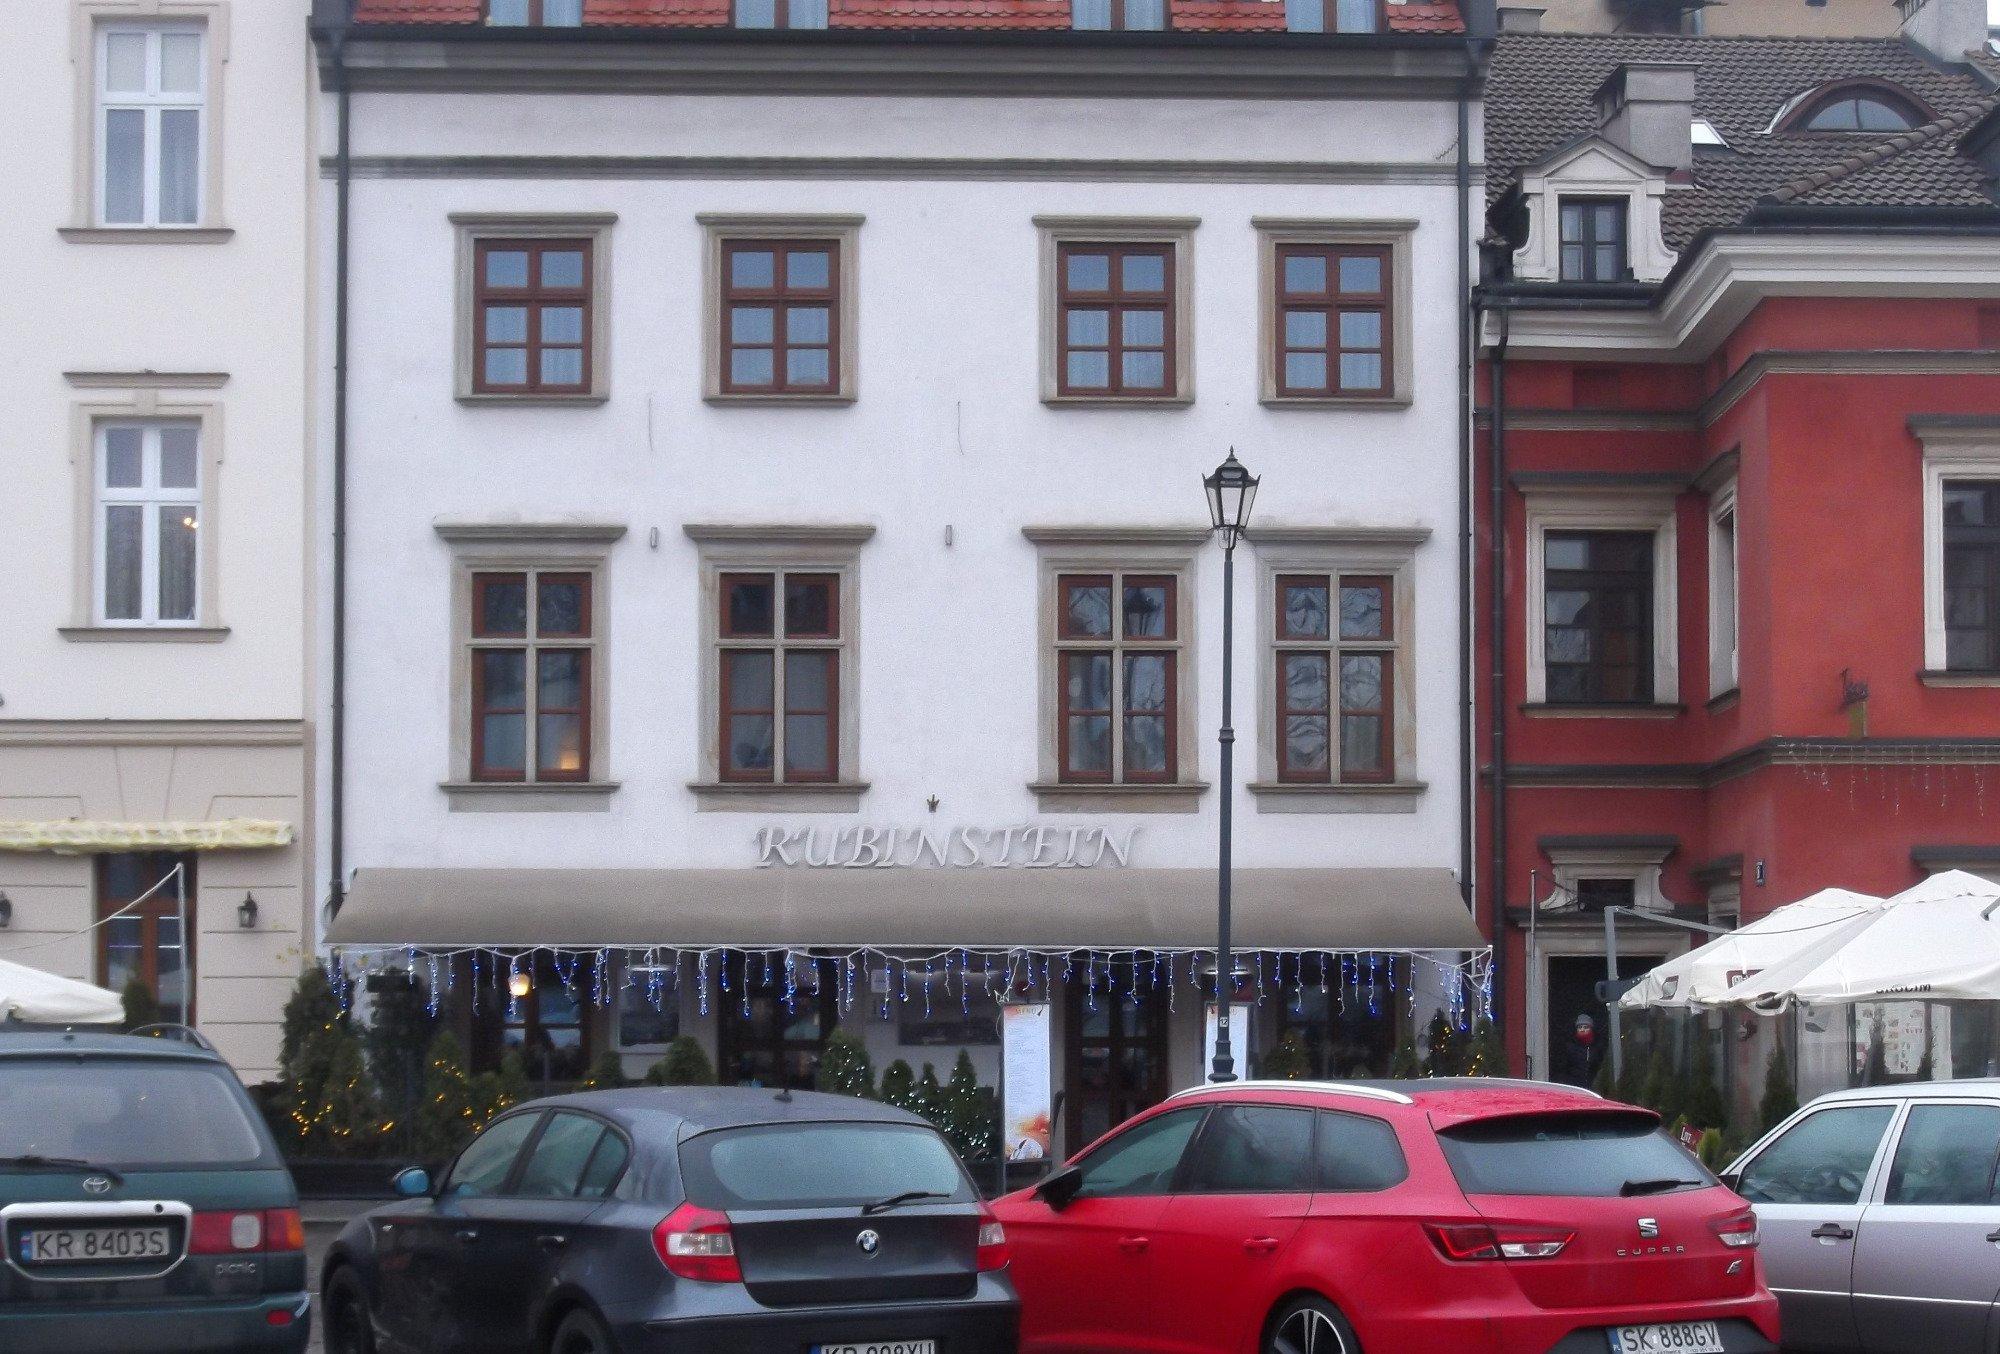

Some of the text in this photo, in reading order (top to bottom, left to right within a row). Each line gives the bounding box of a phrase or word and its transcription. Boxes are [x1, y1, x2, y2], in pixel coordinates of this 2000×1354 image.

[754, 825, 1142, 869] RUBINSTEIN
[36, 1230, 163, 1258] KR 8403S
[1616, 1245, 1685, 1256] CUPRA
[1622, 1323, 1717, 1352] SK 888GV
